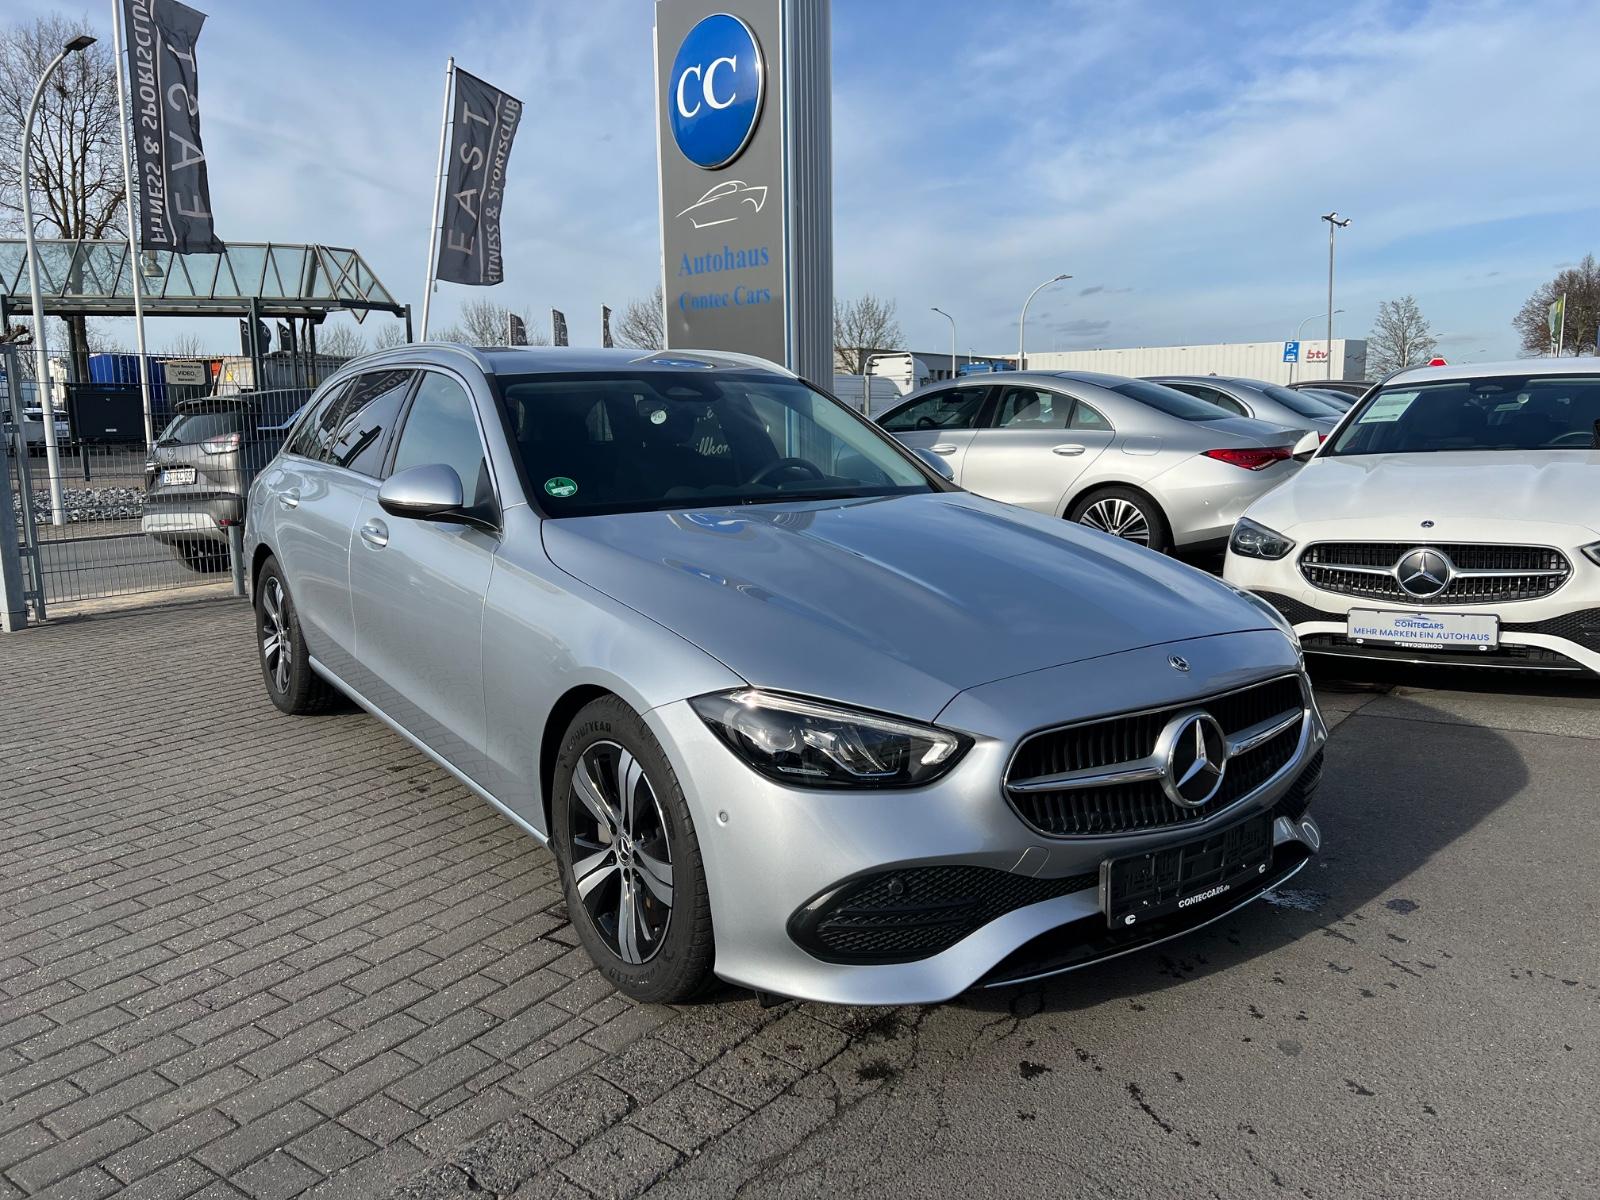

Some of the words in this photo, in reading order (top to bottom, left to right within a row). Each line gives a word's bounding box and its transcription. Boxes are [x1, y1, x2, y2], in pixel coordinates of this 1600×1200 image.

[676, 54, 737, 118] CC
[448, 101, 490, 256] EAST
[485, 205, 499, 220] &
[486, 223, 502, 282] FITNESS
[678, 245, 769, 277] Autohaus
[679, 290, 730, 313] Contec
[733, 284, 771, 307] Cars
[1353, 627, 1377, 635] MEHR
[1380, 629, 1417, 638] MARKEN
[1436, 632, 1490, 641] AUTOHAUS
